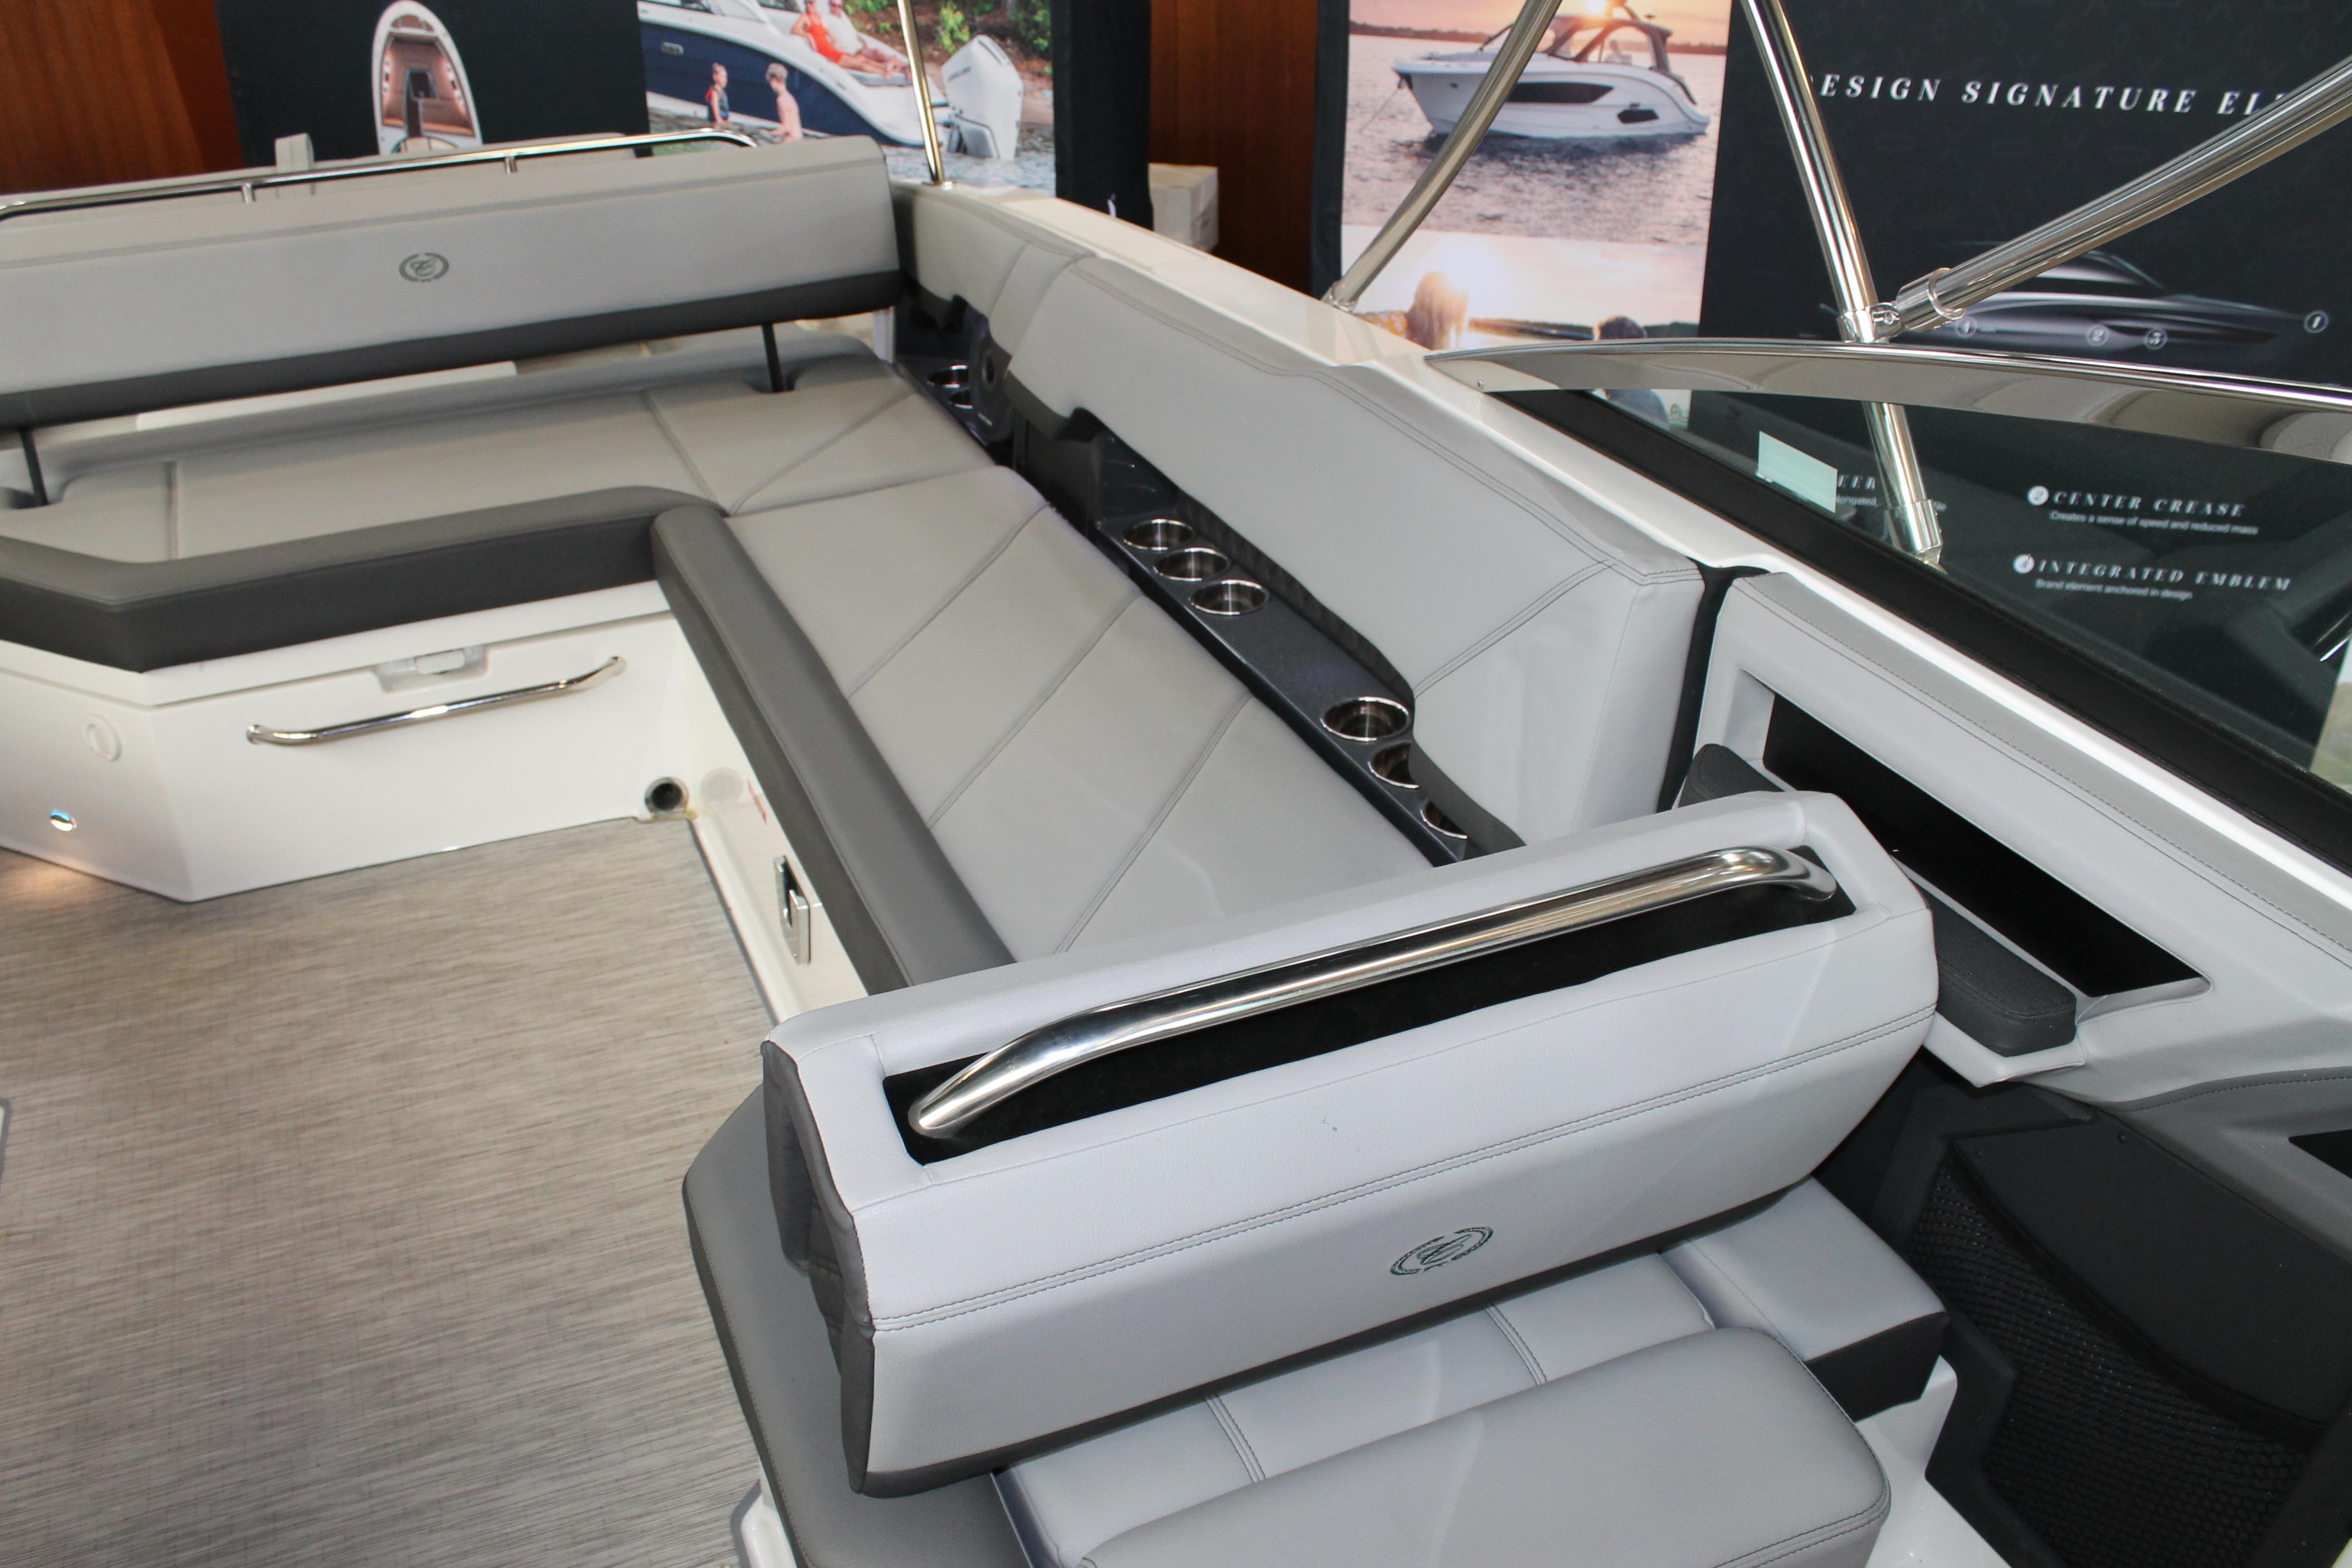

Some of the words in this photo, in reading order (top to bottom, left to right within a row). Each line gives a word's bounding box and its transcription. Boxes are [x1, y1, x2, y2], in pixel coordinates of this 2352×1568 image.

[1810, 73, 1941, 102] ESIGN
[1961, 80, 2197, 113] SIGNATURE
[2217, 90, 2288, 115] EL
[1838, 476, 1876, 489] EER
[2054, 491, 2141, 510] CENTER
[2153, 498, 2246, 518] CREASE
[2039, 560, 2184, 582] INTEGRATED
[2195, 571, 2291, 591] EMBLEM
